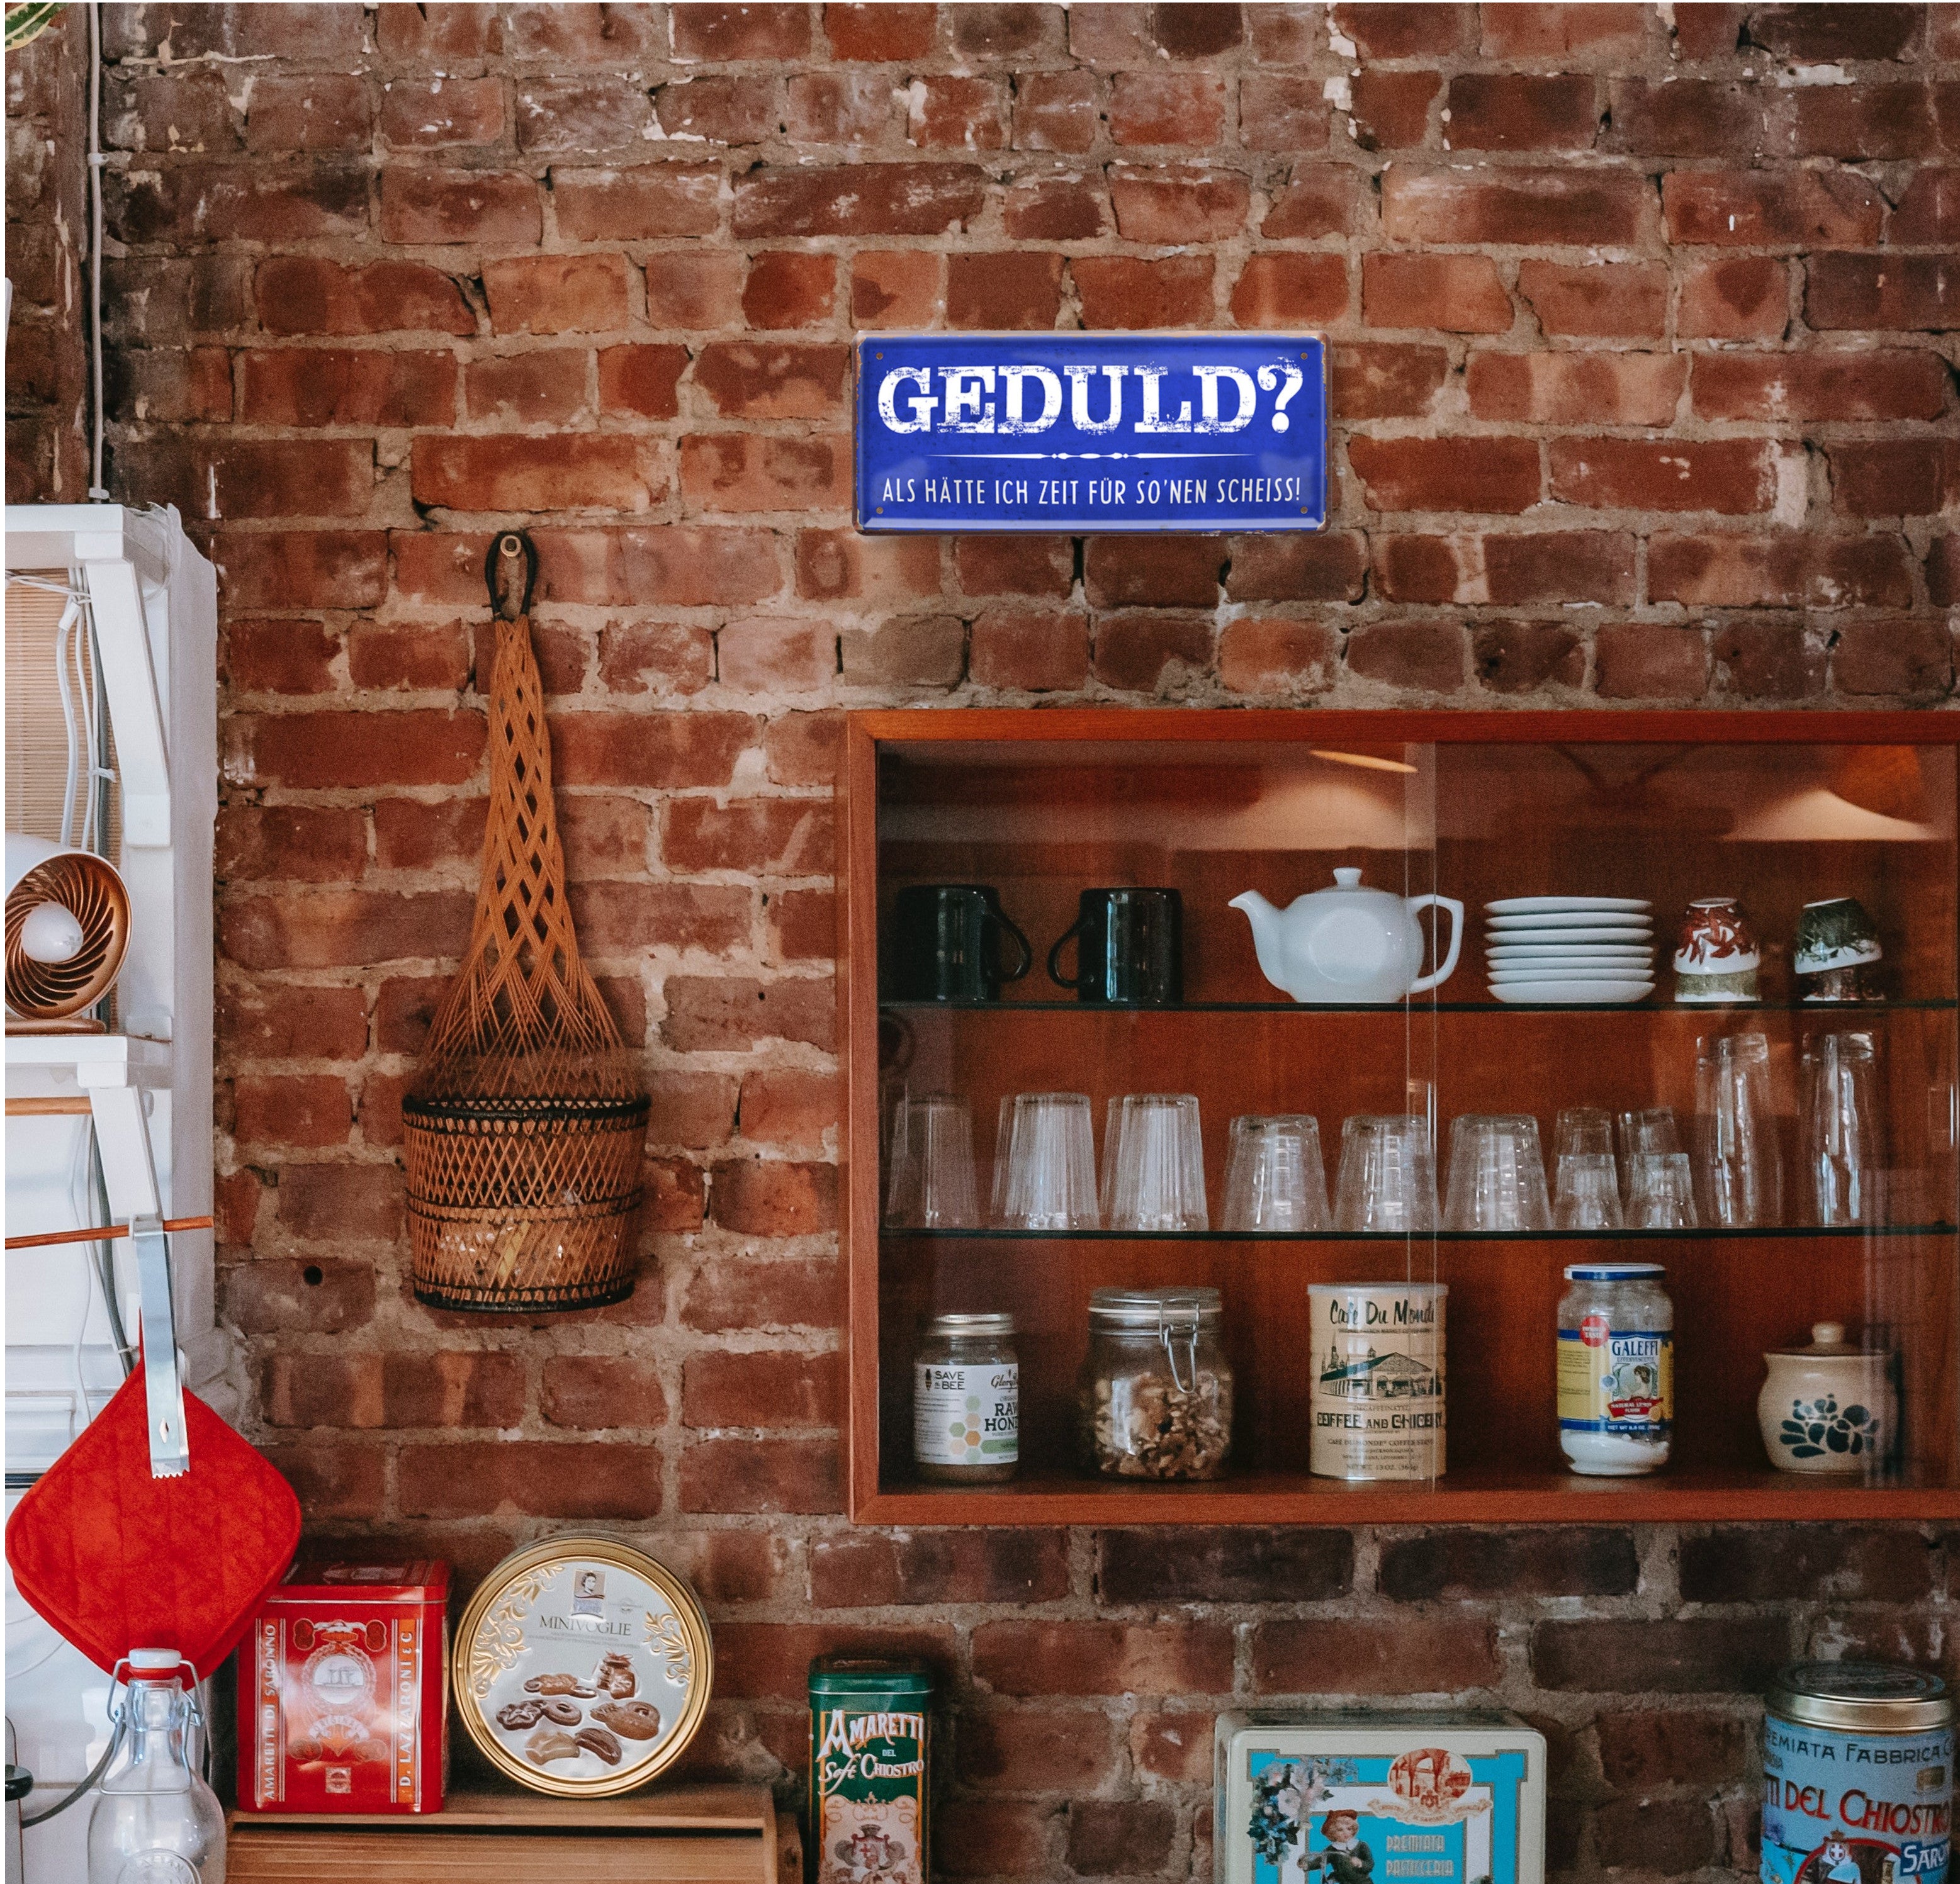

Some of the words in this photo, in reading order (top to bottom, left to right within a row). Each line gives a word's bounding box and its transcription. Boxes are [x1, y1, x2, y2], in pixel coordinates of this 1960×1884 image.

[879, 357, 1302, 436] GEDULD?
[883, 478, 915, 502] ALS
[925, 478, 984, 503] HÄTTE
[996, 481, 1027, 503] ICH
[1039, 481, 1078, 504] ZEIT
[1090, 478, 1125, 504] FÜR
[1137, 479, 1206, 503] SO'NEN
[1217, 478, 1300, 502] SCHEISS!
[1366, 1301, 1388, 1325] Du
[1612, 1341, 1658, 1356] GALEFFI
[935, 1371, 964, 1380] SAVE
[942, 1381, 966, 1390] BEE
[984, 1418, 1018, 1432] HON
[1317, 1411, 1364, 1428] COFFEE
[1366, 1418, 1388, 1428] AND
[539, 1615, 631, 1636] MINIVOGLIE
[264, 1623, 276, 1697] SARONNO
[265, 1704, 276, 1720] DI
[399, 1660, 412, 1763] LAZZARONI
[817, 1709, 924, 1759] AMARETTI
[1846, 1742, 1940, 1764] FABBRICA
[860, 1753, 924, 1779] CHIOSTRO
[399, 1769, 412, 1786] D.
[1785, 1780, 1831, 1820] DEL
